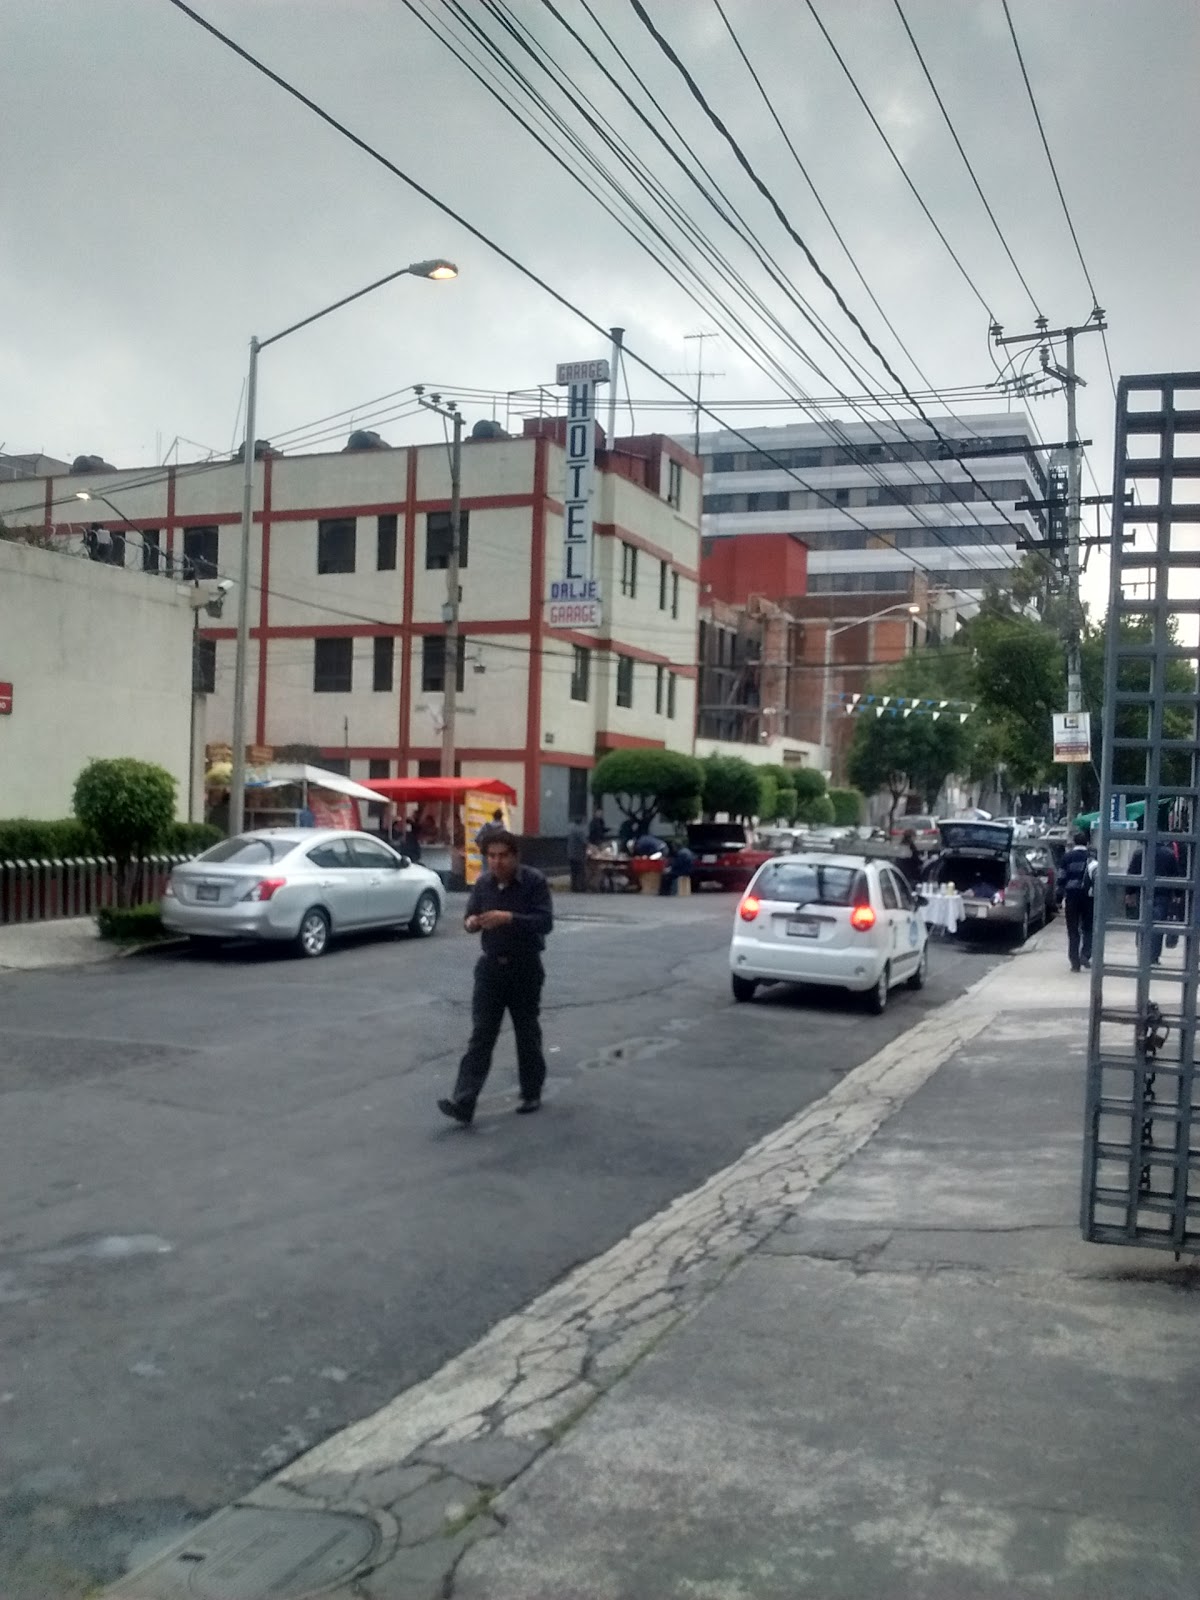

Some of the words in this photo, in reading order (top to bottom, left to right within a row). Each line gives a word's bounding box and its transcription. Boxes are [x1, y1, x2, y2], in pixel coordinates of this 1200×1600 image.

[558, 362, 603, 381] GARAGE
[566, 383, 589, 579] HOTEL
[551, 605, 596, 623] GARAGE
